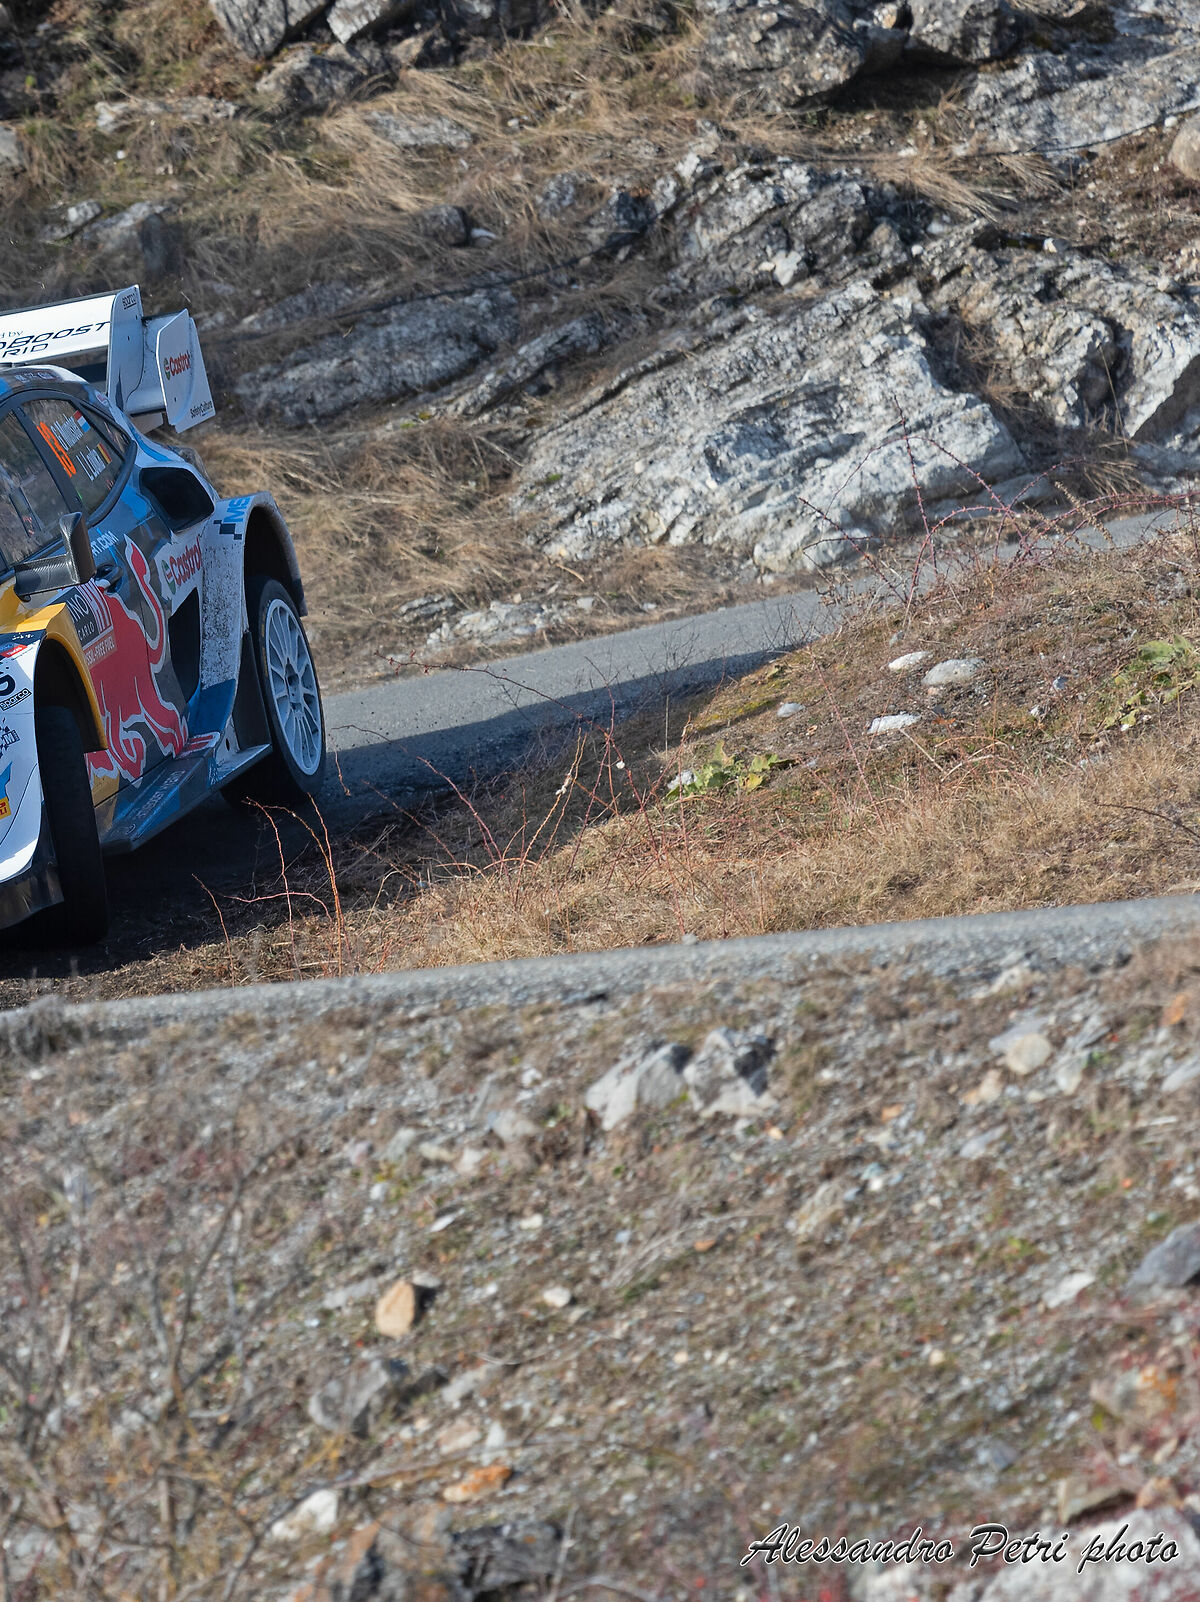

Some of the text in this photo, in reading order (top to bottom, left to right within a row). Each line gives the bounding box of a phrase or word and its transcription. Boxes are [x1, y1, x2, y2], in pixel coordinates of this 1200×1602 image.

[8, 330, 24, 339] by
[168, 535, 202, 588] Castrol
[0, 688, 31, 710] sparco
